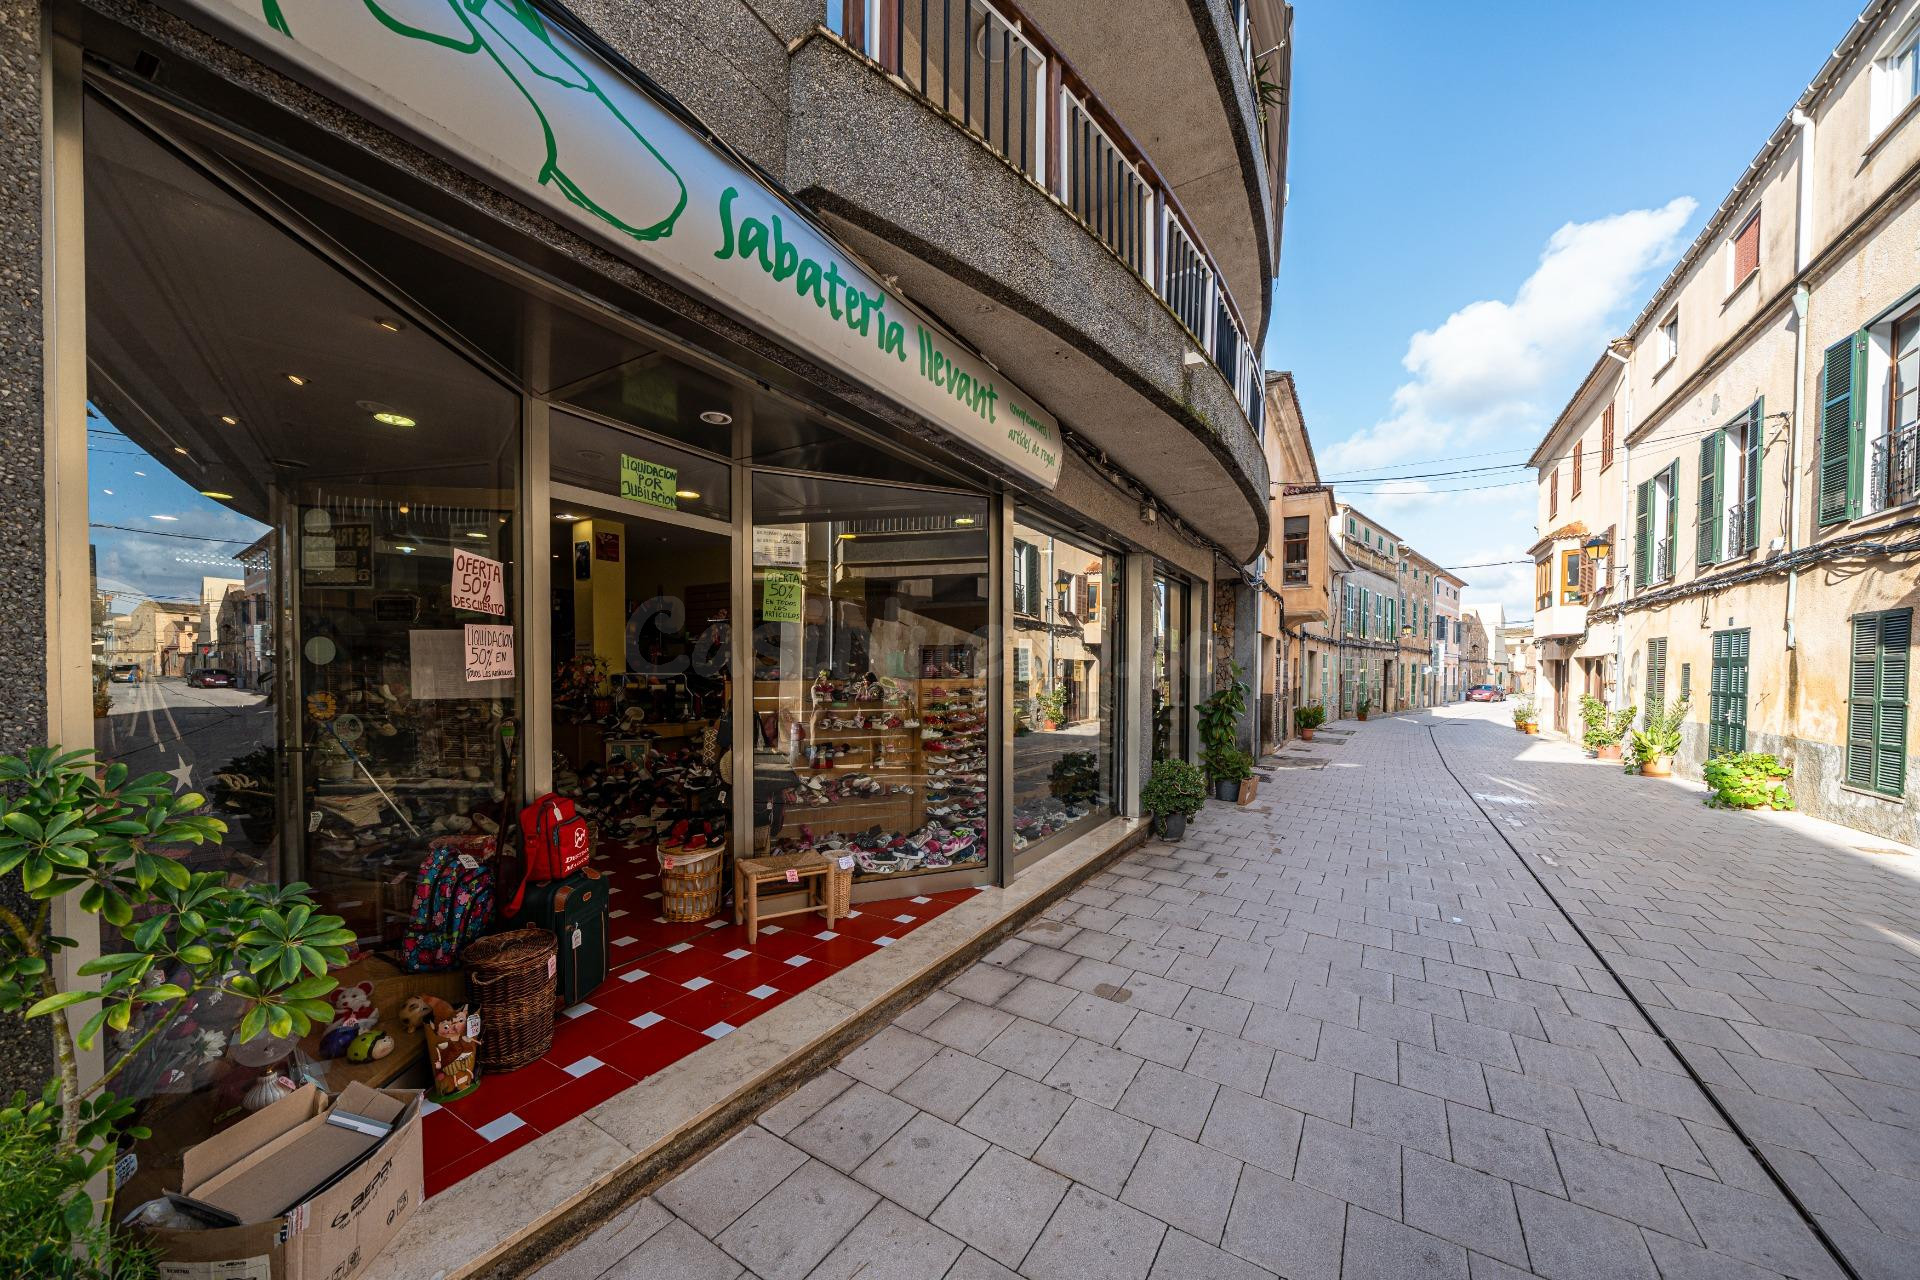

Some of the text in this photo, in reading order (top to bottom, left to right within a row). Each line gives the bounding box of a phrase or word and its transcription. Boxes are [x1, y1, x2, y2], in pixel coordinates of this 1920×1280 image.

[917, 324, 1000, 425] llevant
[638, 474, 663, 491] POR
[456, 554, 501, 583] OFERTA
[460, 573, 491, 603] 50%
[769, 583, 796, 600] 50%
[453, 594, 504, 615] DESCUENTO
[775, 599, 797, 607] TODOS
[468, 647, 507, 670] 50% EN
